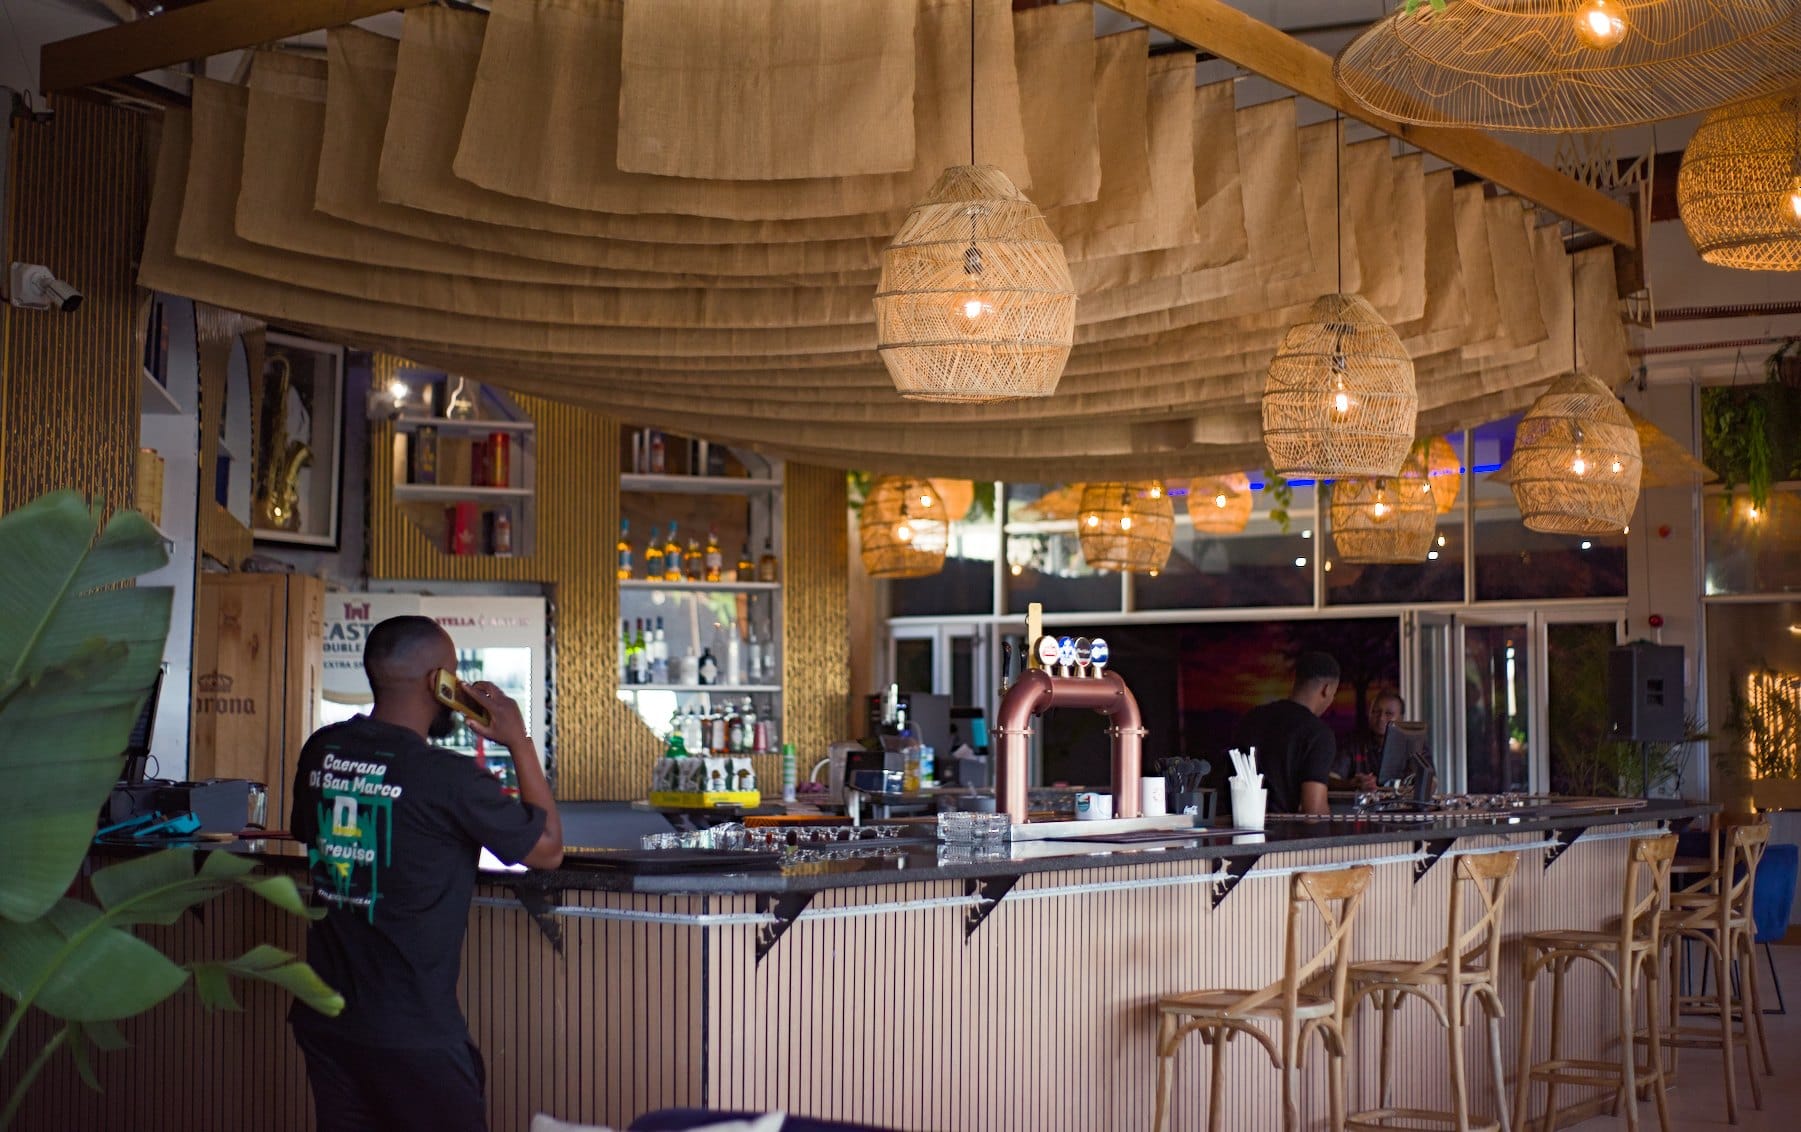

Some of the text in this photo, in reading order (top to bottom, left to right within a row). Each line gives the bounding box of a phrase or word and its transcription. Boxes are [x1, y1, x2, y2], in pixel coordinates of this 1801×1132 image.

[323, 621, 374, 640] AST
[323, 753, 387, 776] Caerano
[309, 770, 402, 798] Di San Marco
[319, 838, 375, 862] Treviso
